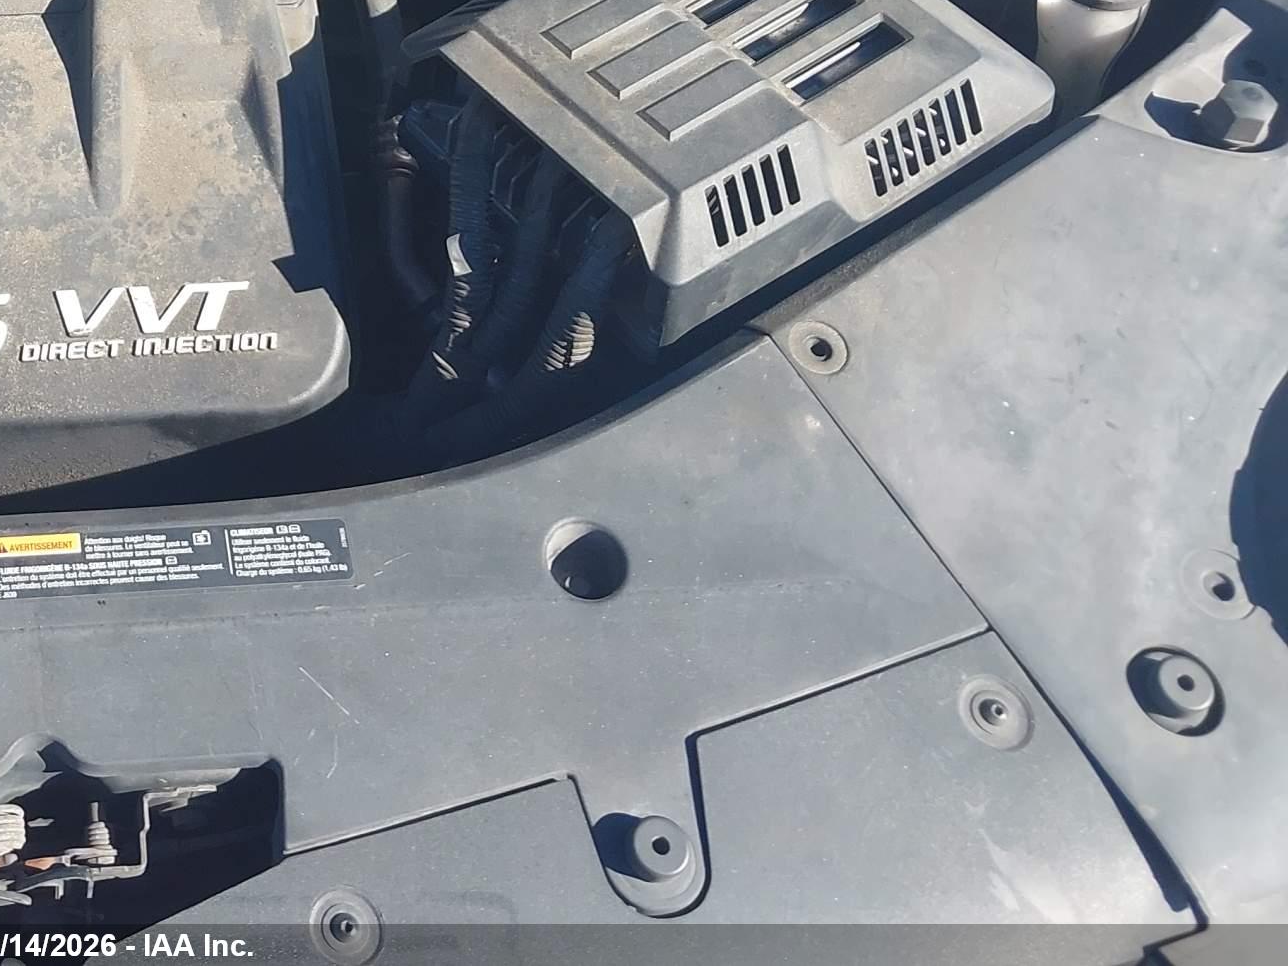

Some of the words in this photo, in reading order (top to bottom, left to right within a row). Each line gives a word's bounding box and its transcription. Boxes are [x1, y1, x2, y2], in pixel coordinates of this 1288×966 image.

[53, 280, 250, 337] VVT
[19, 338, 125, 362] DIRECT
[132, 332, 278, 357] INJECTION
[10, 541, 72, 551] AVERTISSEMENT
